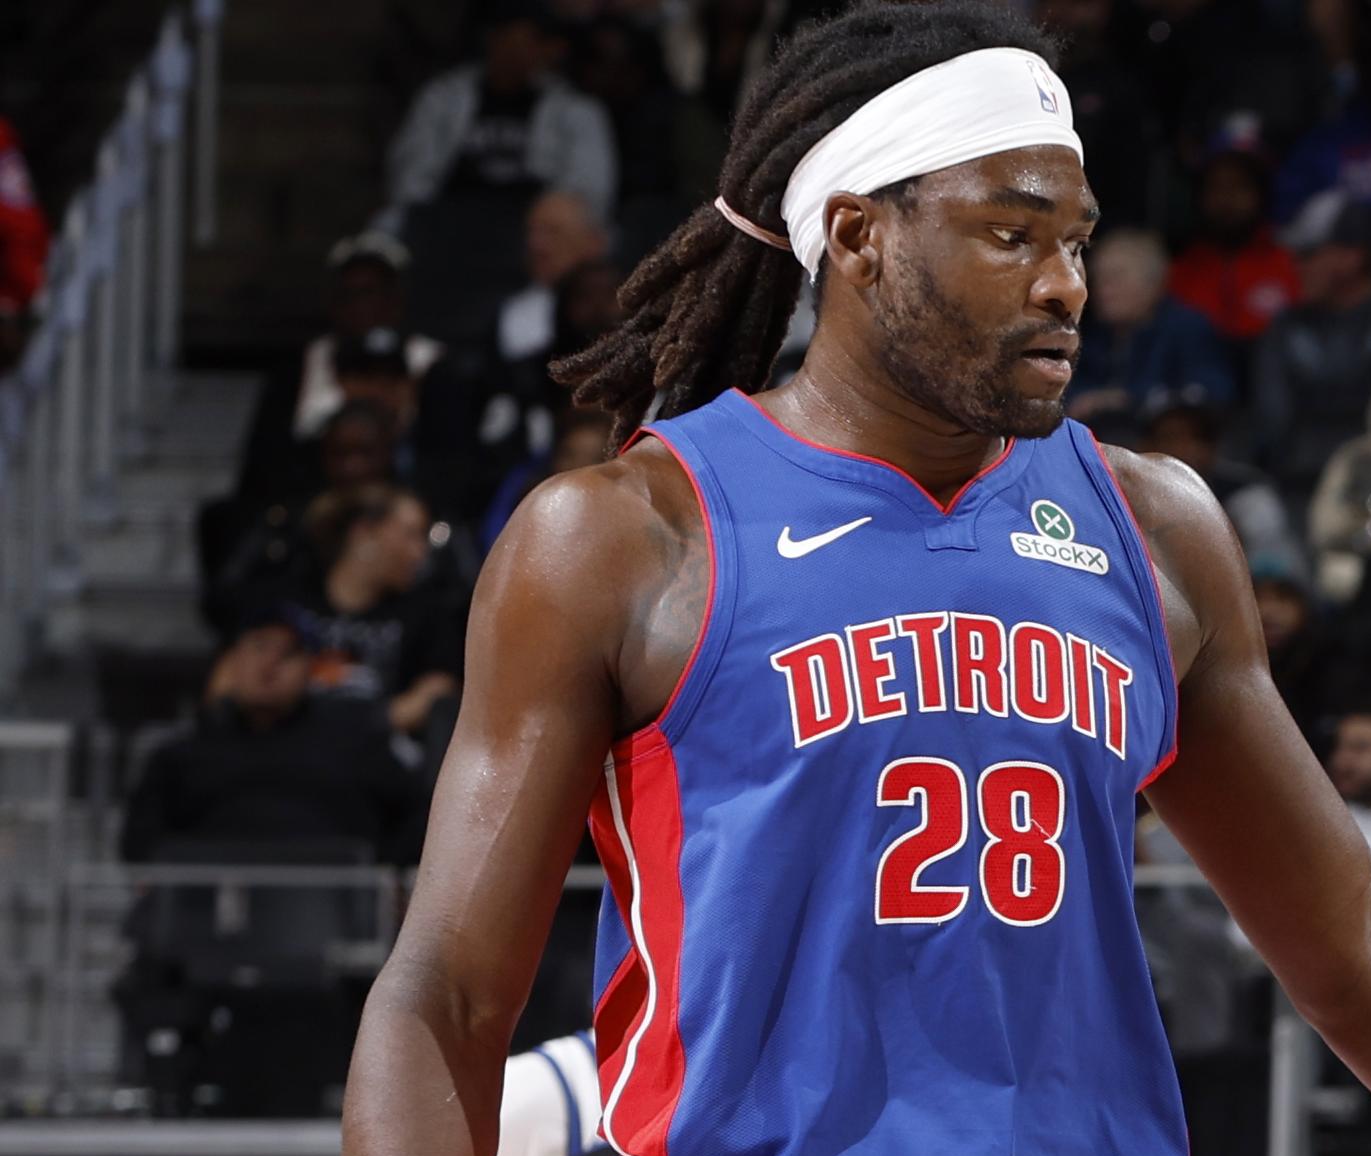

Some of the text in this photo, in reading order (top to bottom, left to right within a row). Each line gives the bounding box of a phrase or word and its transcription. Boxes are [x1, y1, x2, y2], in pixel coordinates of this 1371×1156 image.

[1015, 536, 1105, 570] StockX
[770, 611, 1133, 760] DETROIT
[875, 756, 1066, 927] 28
